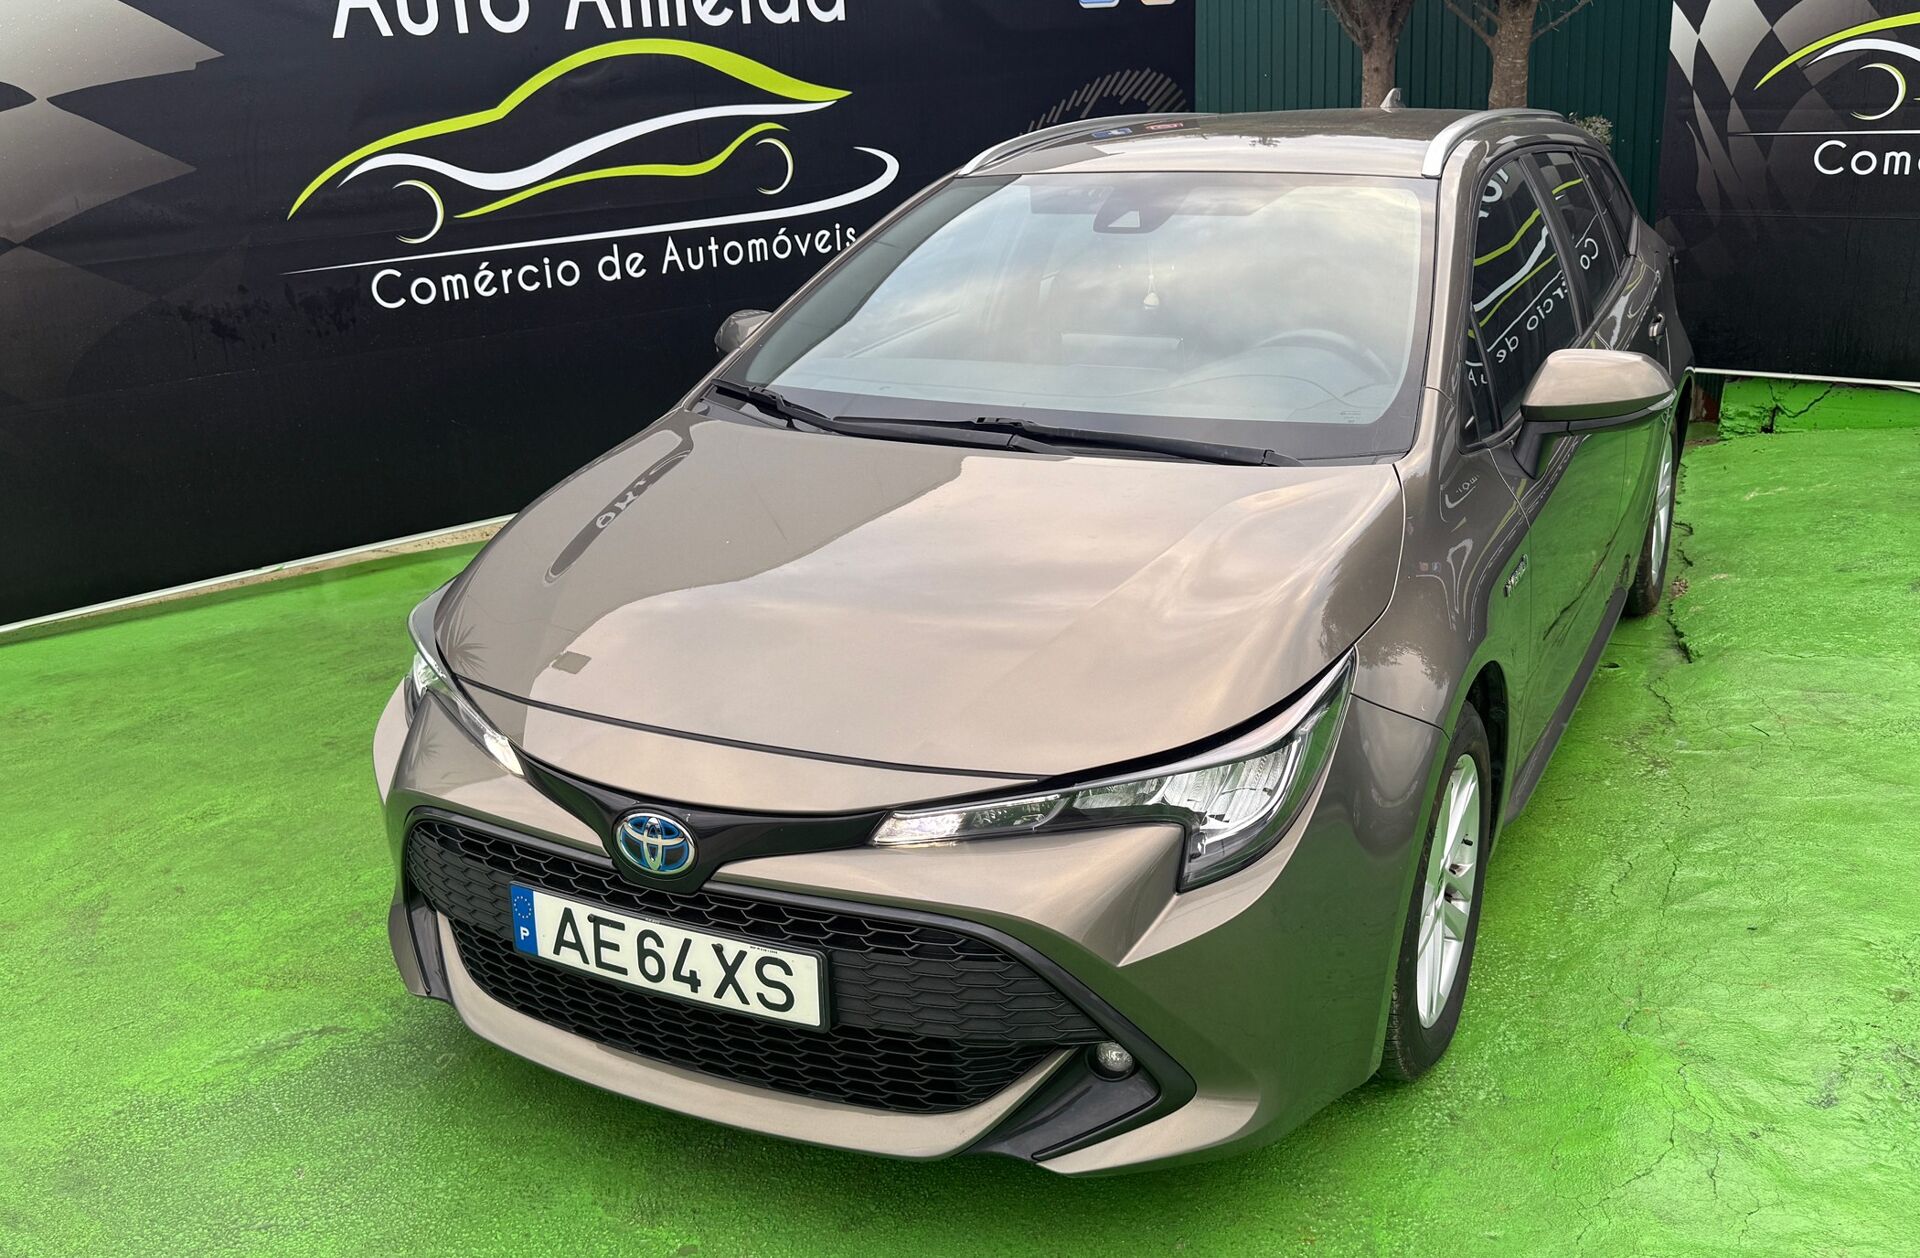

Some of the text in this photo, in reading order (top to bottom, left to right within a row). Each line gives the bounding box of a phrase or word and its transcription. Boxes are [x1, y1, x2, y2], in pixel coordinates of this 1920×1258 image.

[1813, 139, 1920, 176] Com
[371, 223, 856, 309] Comércio de Automóveis
[520, 926, 530, 940] P
